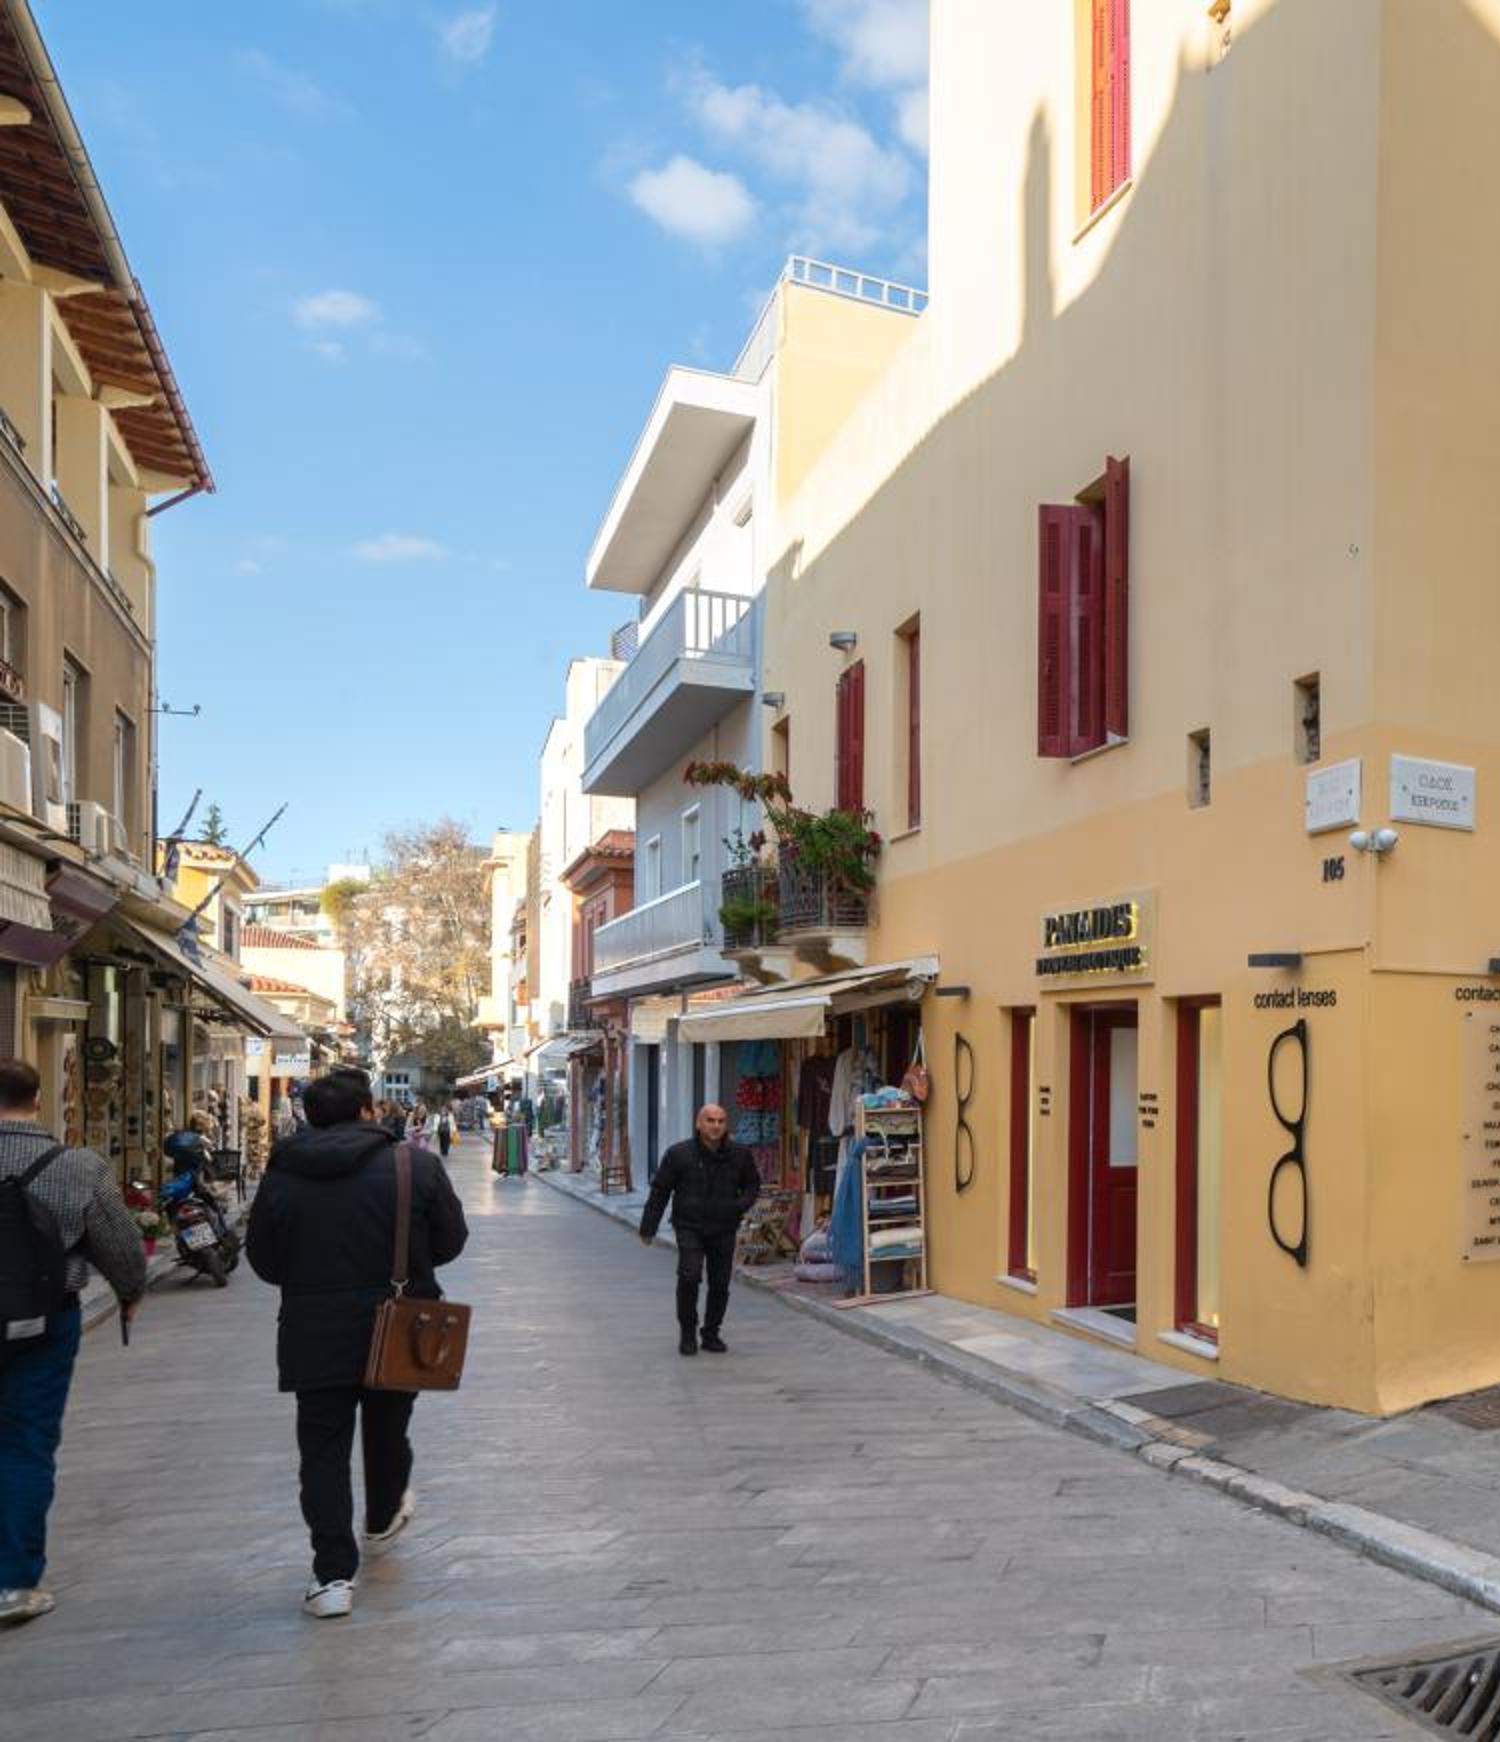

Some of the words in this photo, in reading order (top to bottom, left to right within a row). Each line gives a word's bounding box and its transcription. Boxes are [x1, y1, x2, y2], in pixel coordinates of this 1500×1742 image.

[1321, 856, 1345, 882] 105
[1254, 989, 1295, 1009] contact
[1297, 986, 1337, 1008] lenses
